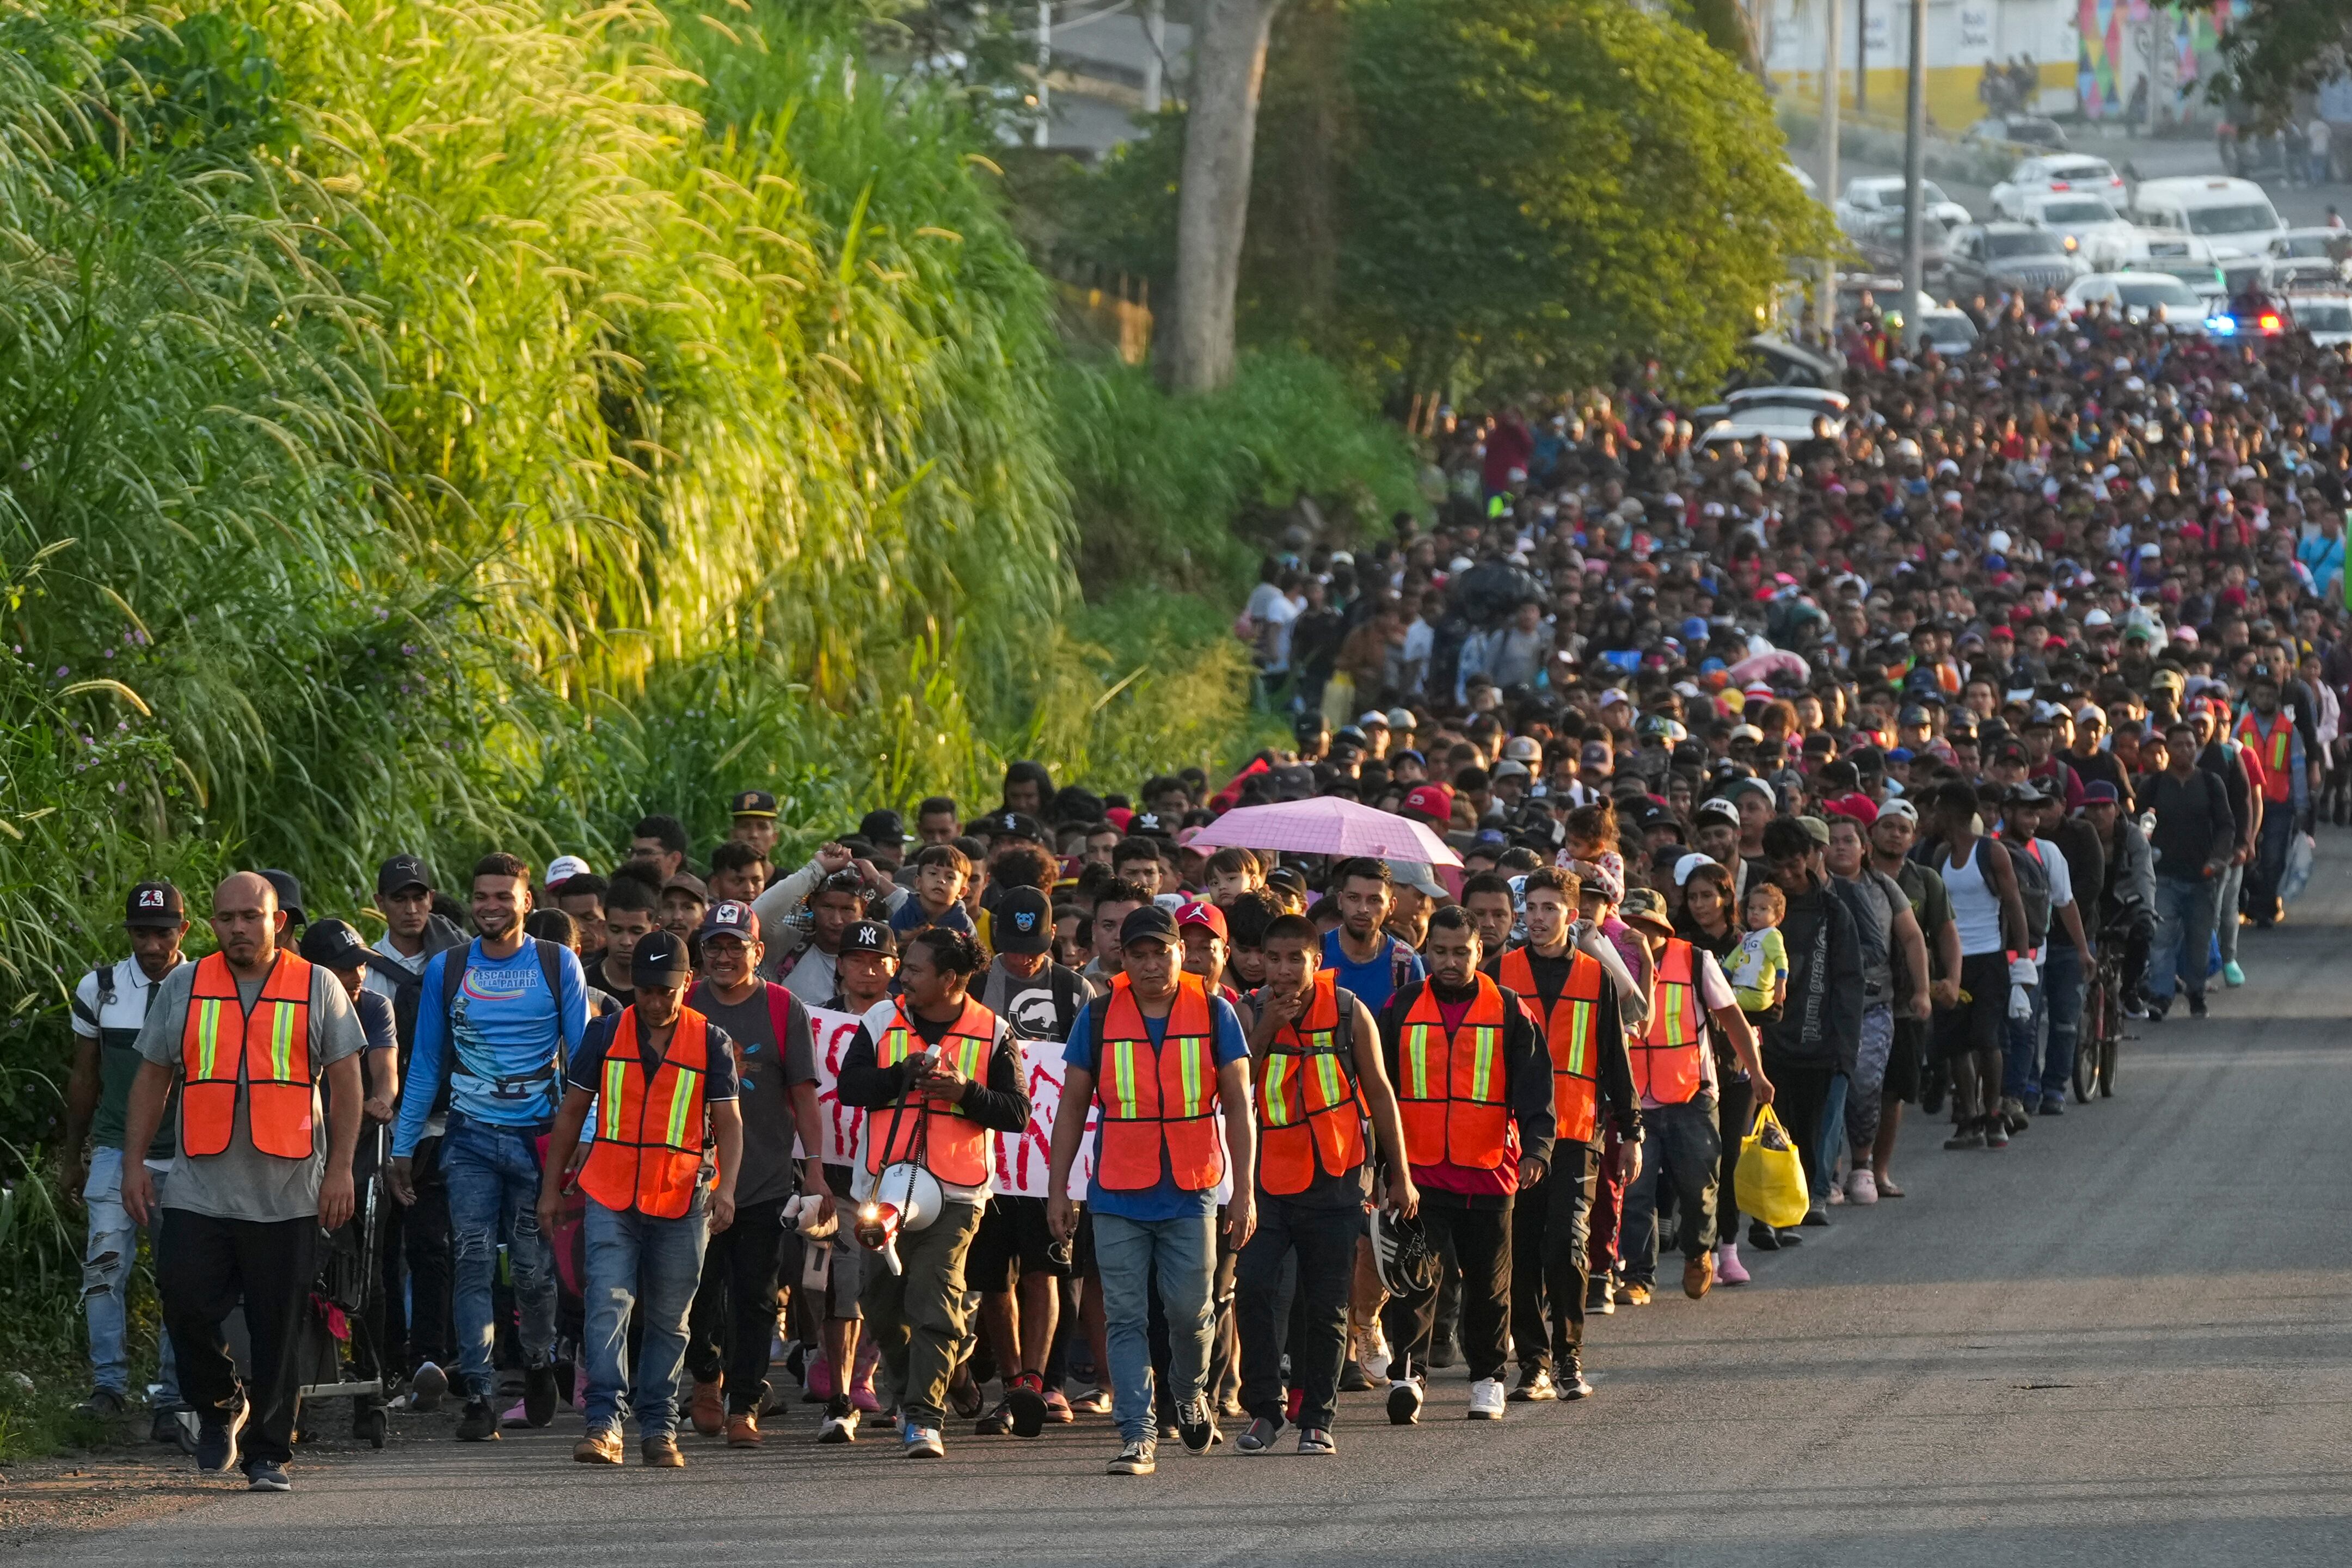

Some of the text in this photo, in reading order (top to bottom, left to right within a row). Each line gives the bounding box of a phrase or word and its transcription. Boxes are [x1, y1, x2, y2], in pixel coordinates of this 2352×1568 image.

[744, 794, 759, 810] P
[139, 889, 164, 907] 23
[340, 930, 360, 946] LA
[858, 926, 877, 945] NY
[473, 970, 537, 980] PESCADORES
[500, 979, 537, 988] PATRIA
